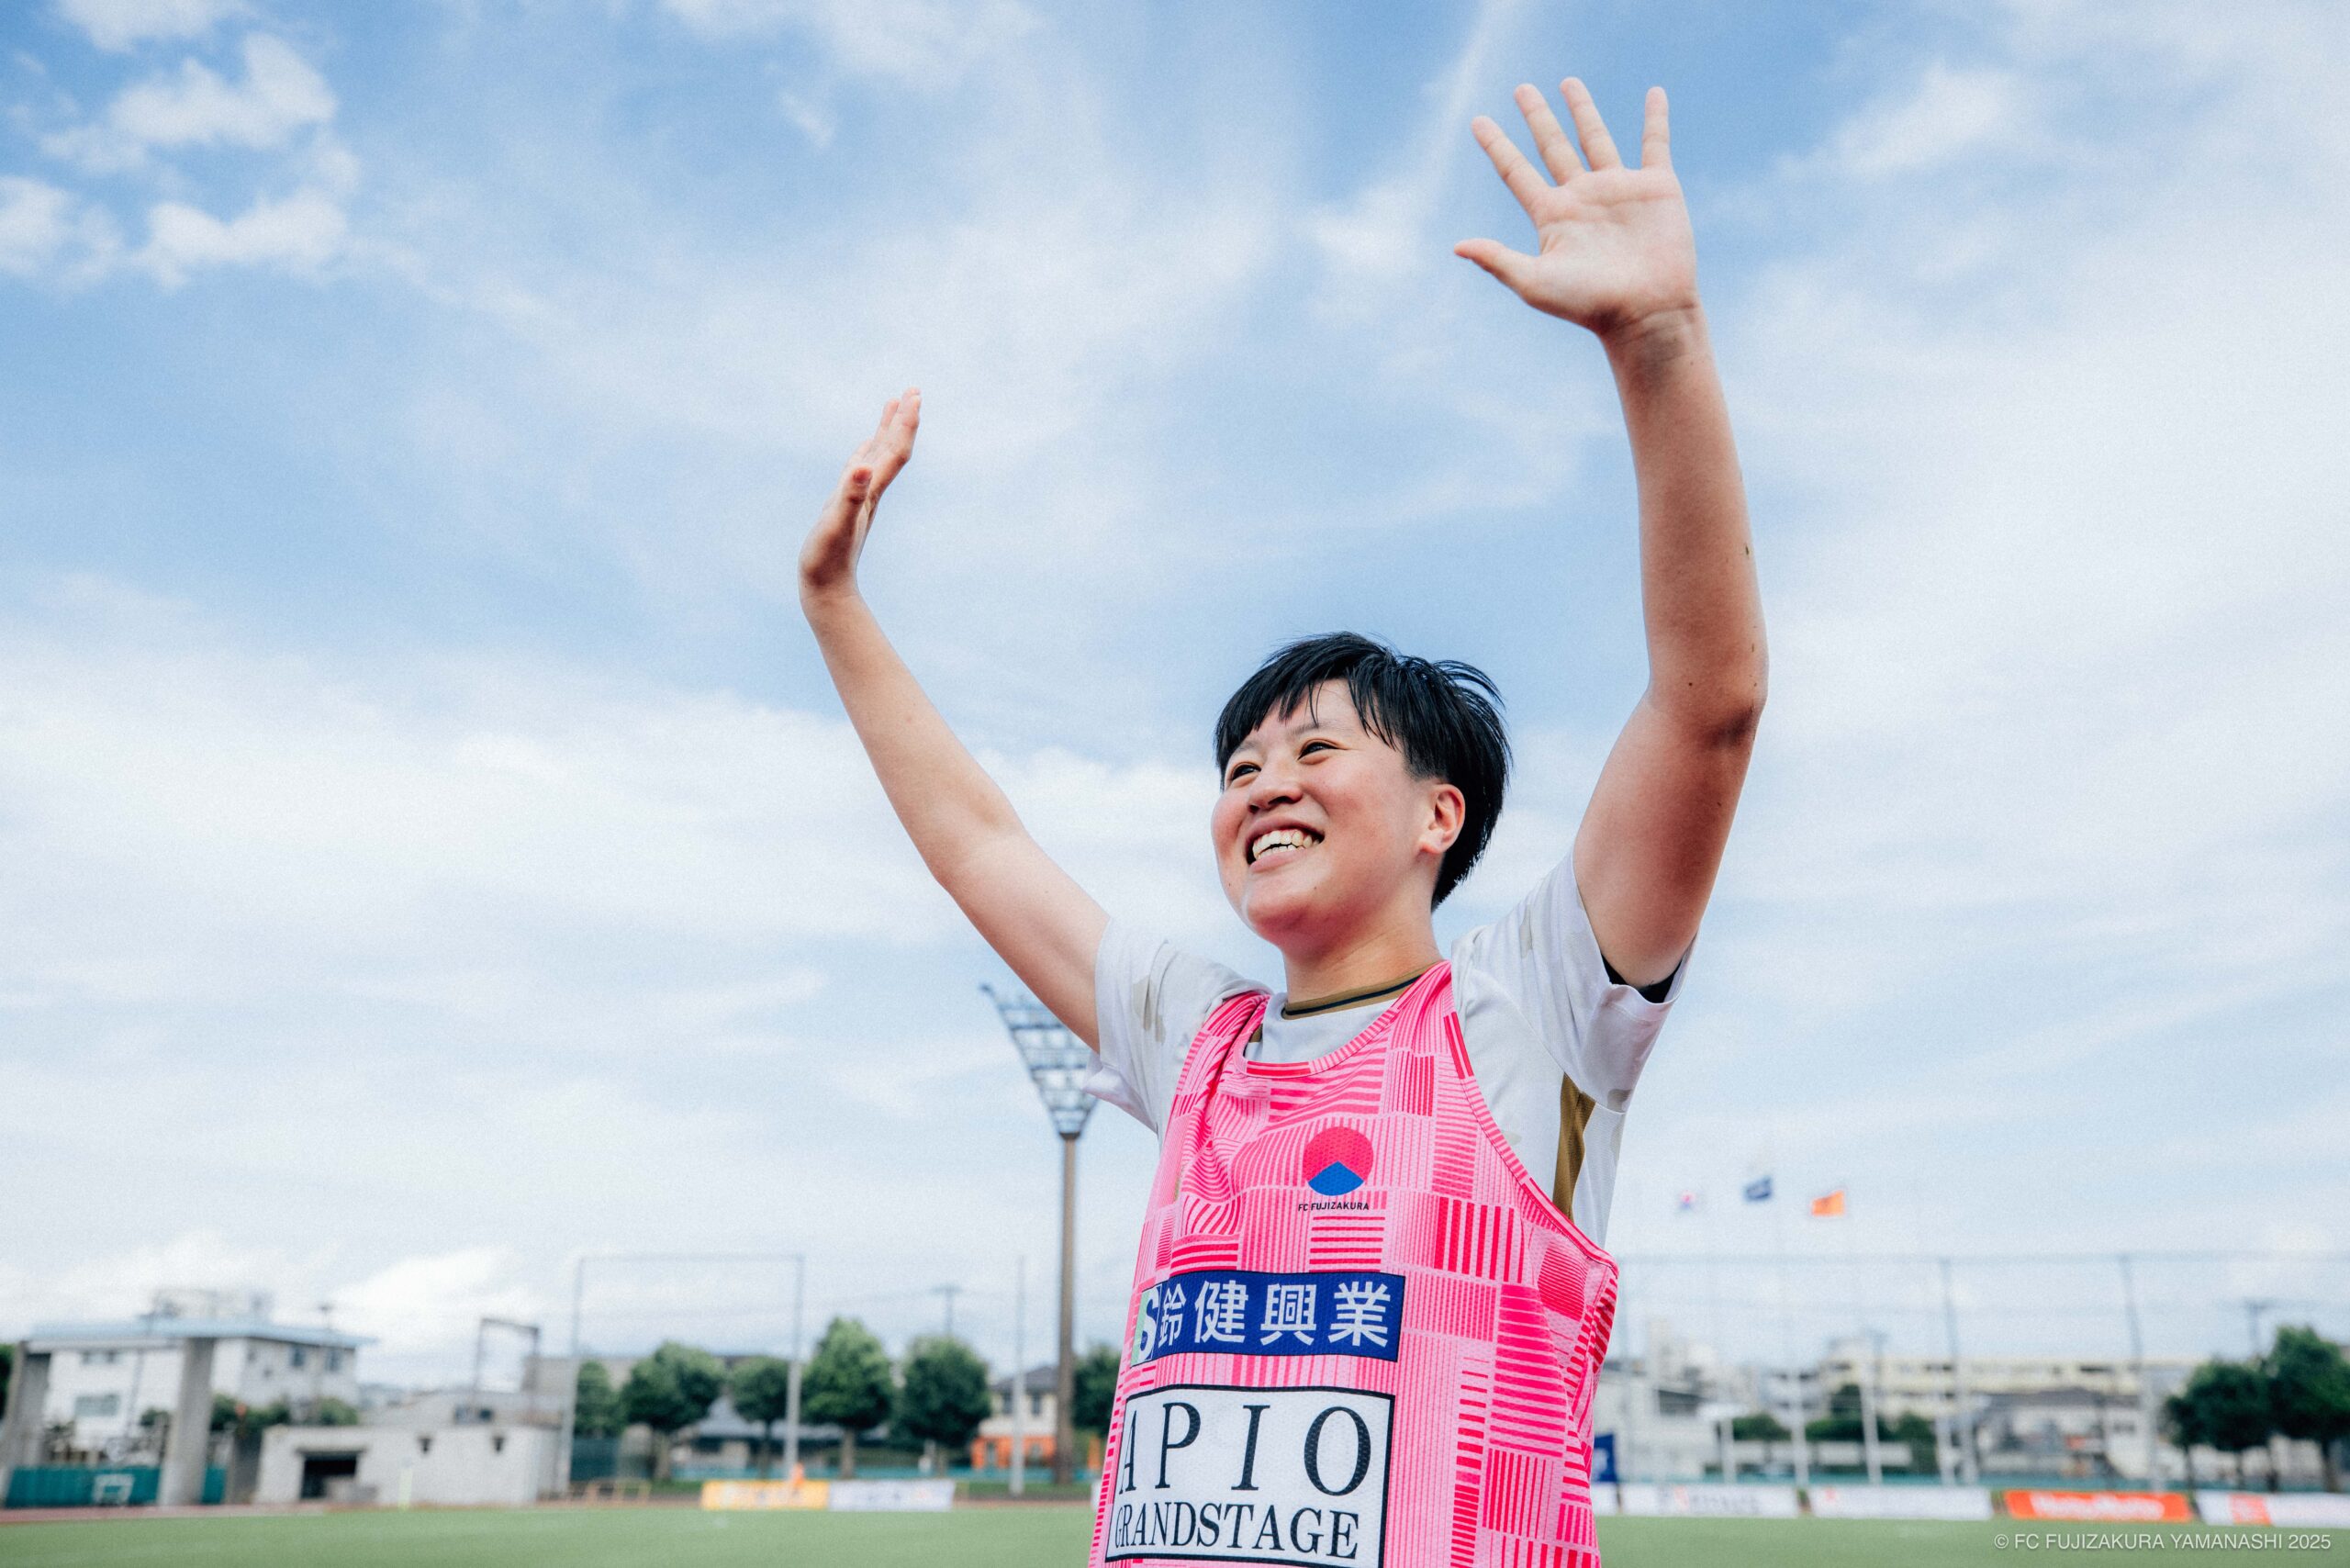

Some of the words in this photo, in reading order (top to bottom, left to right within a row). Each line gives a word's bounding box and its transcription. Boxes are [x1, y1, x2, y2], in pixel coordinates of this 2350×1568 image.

[1298, 1204, 1308, 1212] FC
[1311, 1201, 1370, 1211] FUJIZAKURA
[1158, 1279, 1391, 1349] 鈴健興業
[1118, 1401, 1372, 1497] APIO
[1114, 1501, 1360, 1560] GRANDSTAGE
